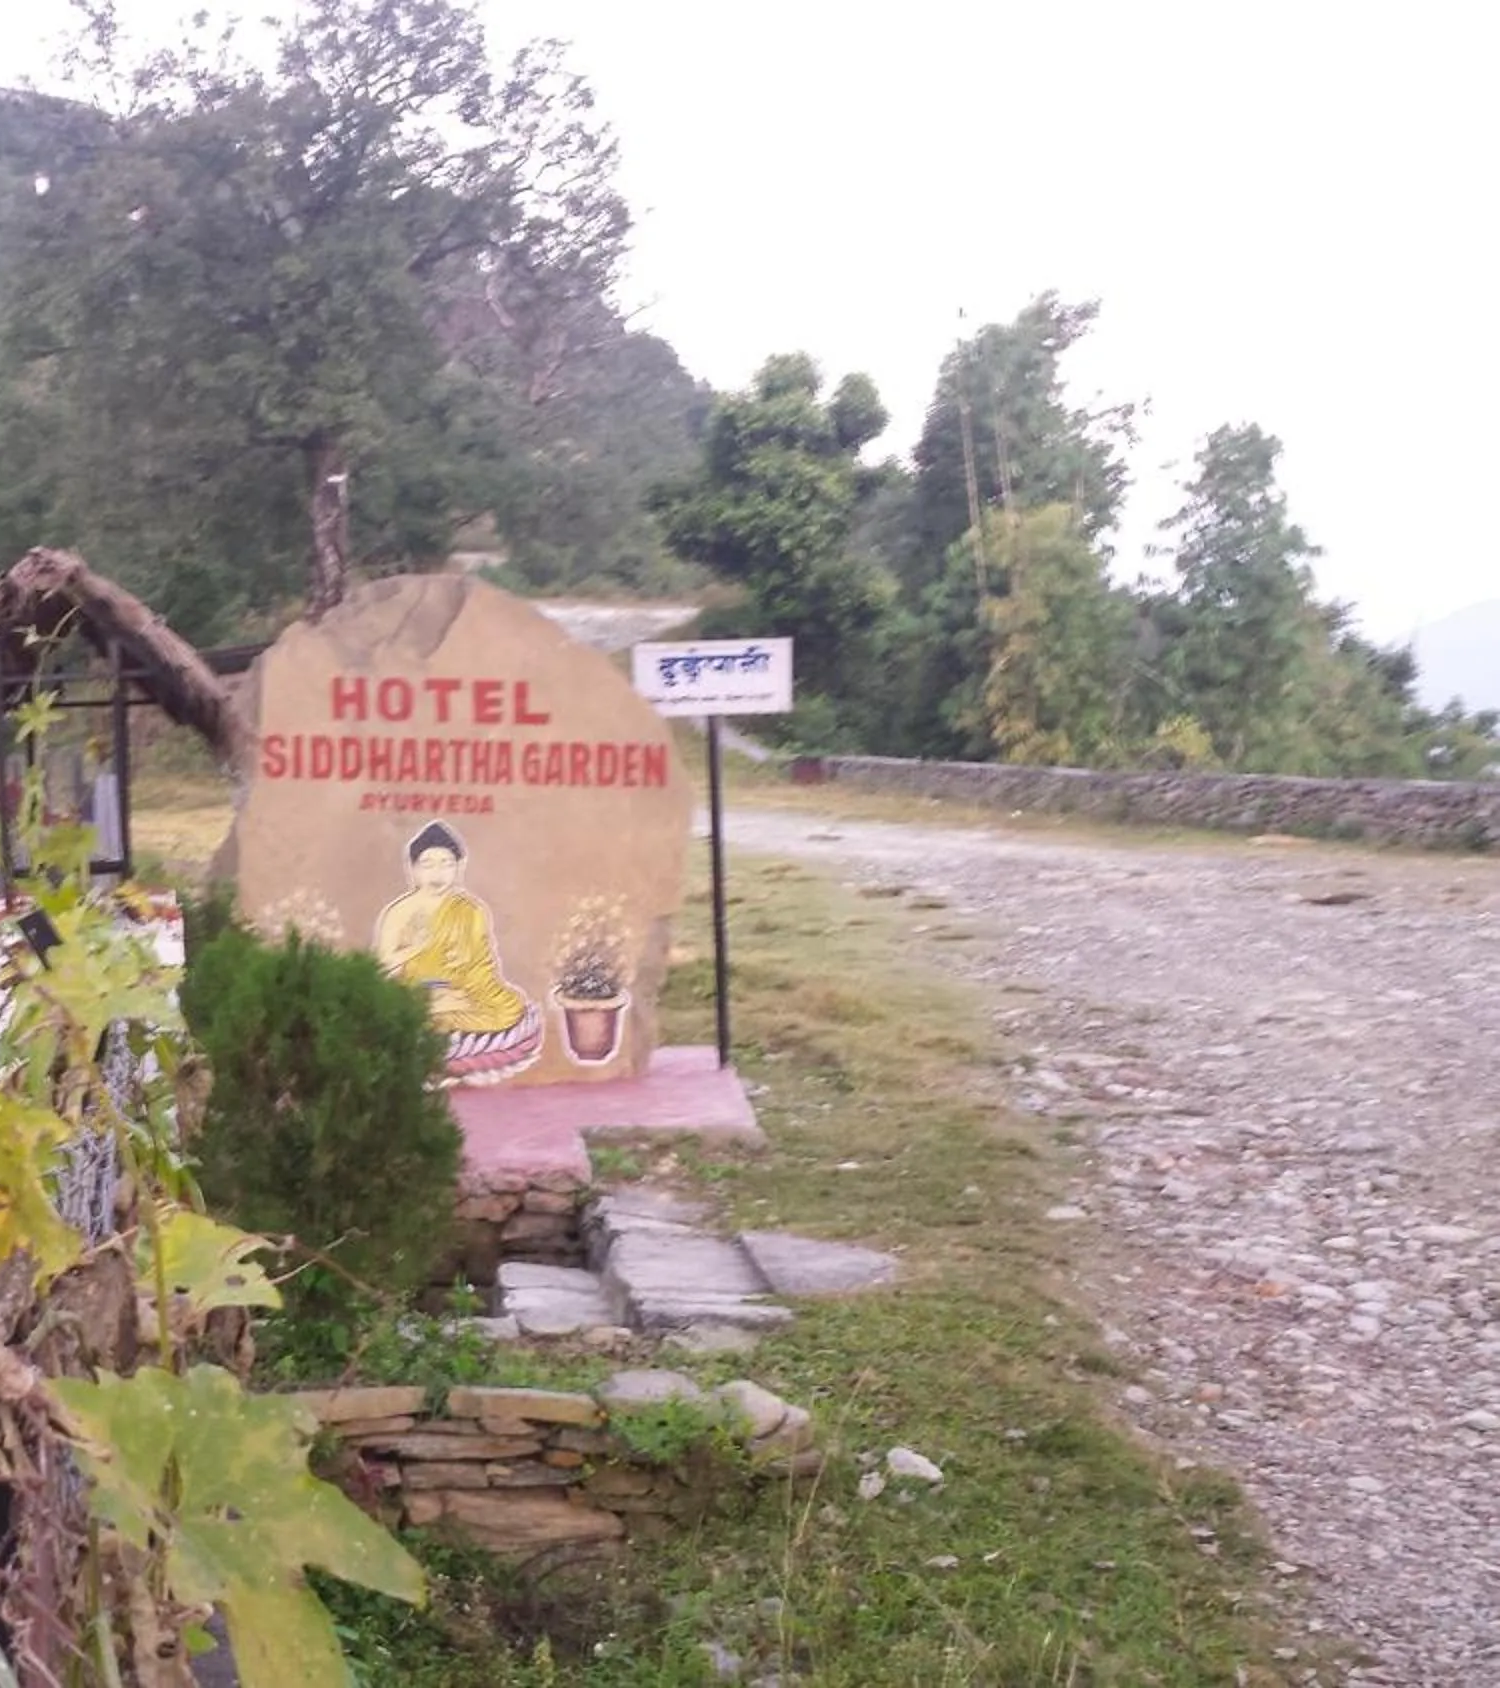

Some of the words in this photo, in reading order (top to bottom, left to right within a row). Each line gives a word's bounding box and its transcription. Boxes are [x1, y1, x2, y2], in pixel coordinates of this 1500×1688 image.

[331, 676, 551, 725] HOTEL
[262, 734, 513, 786] SIDDHARTHA
[522, 741, 668, 788] GARDEN
[359, 792, 494, 814] AYURVEDA
